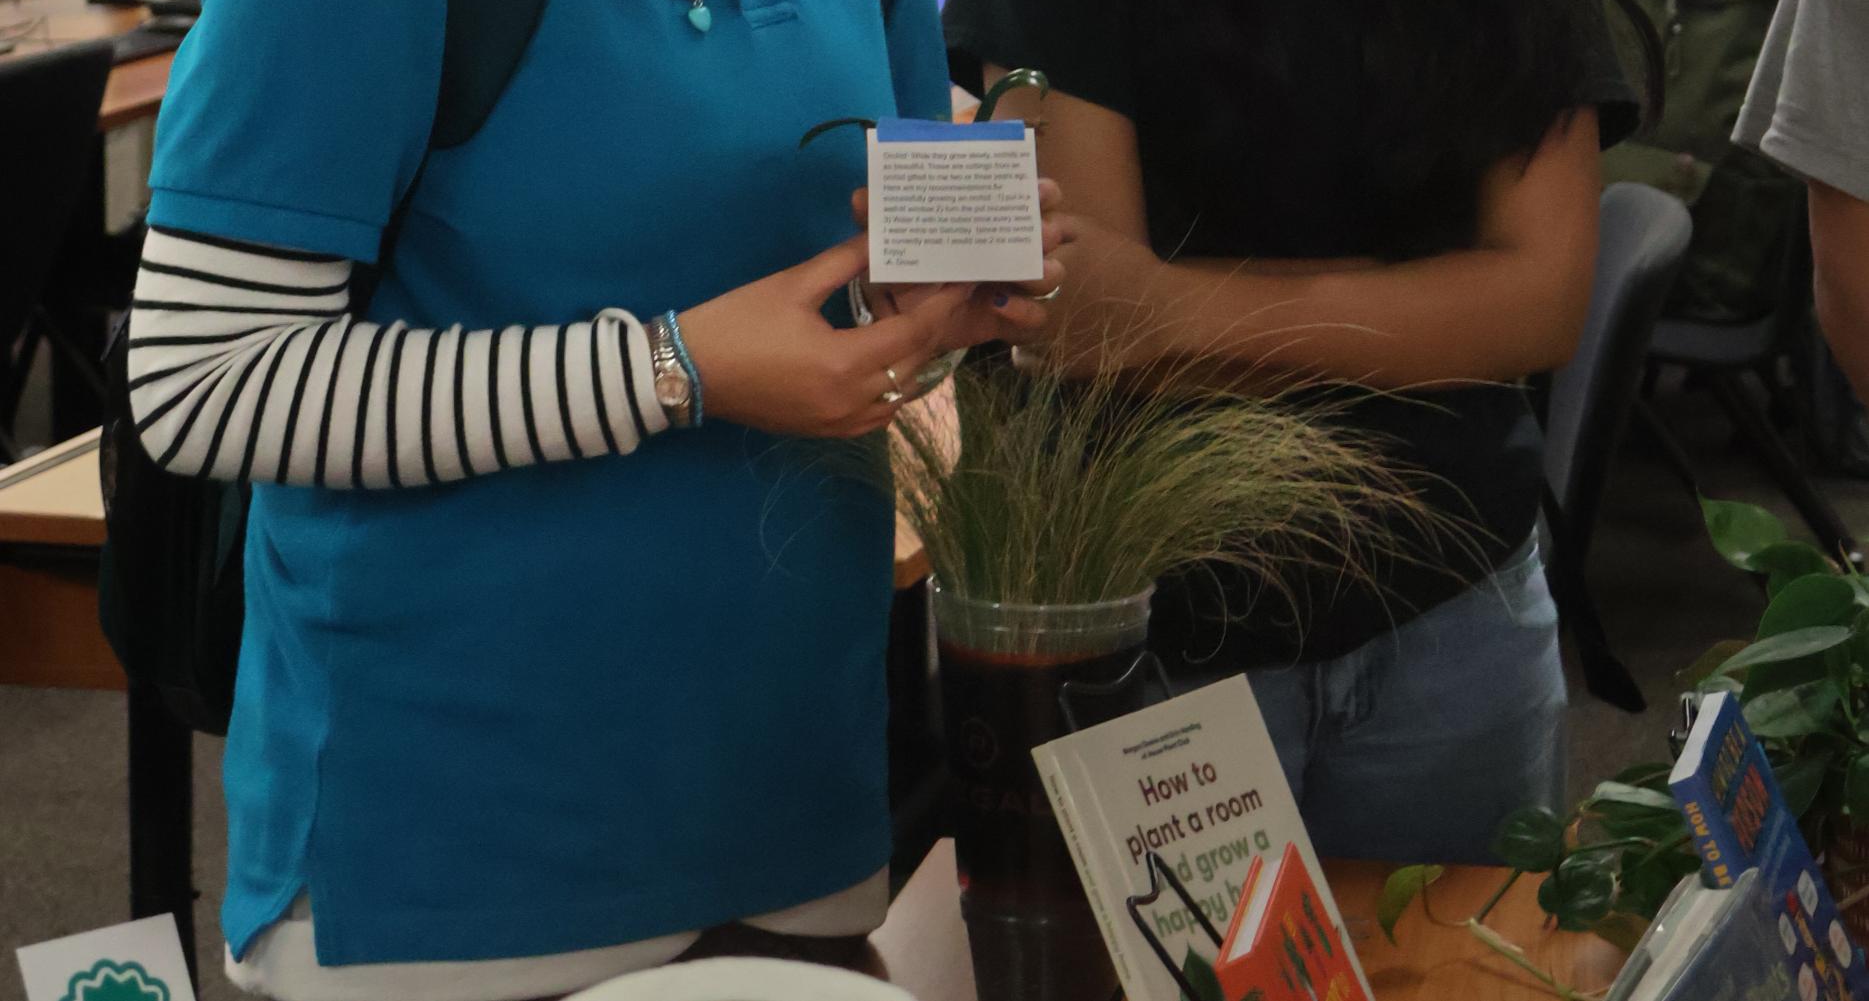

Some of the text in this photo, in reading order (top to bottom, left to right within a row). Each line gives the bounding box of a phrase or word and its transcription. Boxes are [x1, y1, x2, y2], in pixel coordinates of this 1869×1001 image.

[1138, 762, 1217, 806] How to
[1126, 788, 1263, 865] plant a room
[1684, 801, 1710, 836] HOW
[1702, 839, 1720, 862] TO
[1196, 836, 1250, 882] grow
[1254, 830, 1270, 850] a
